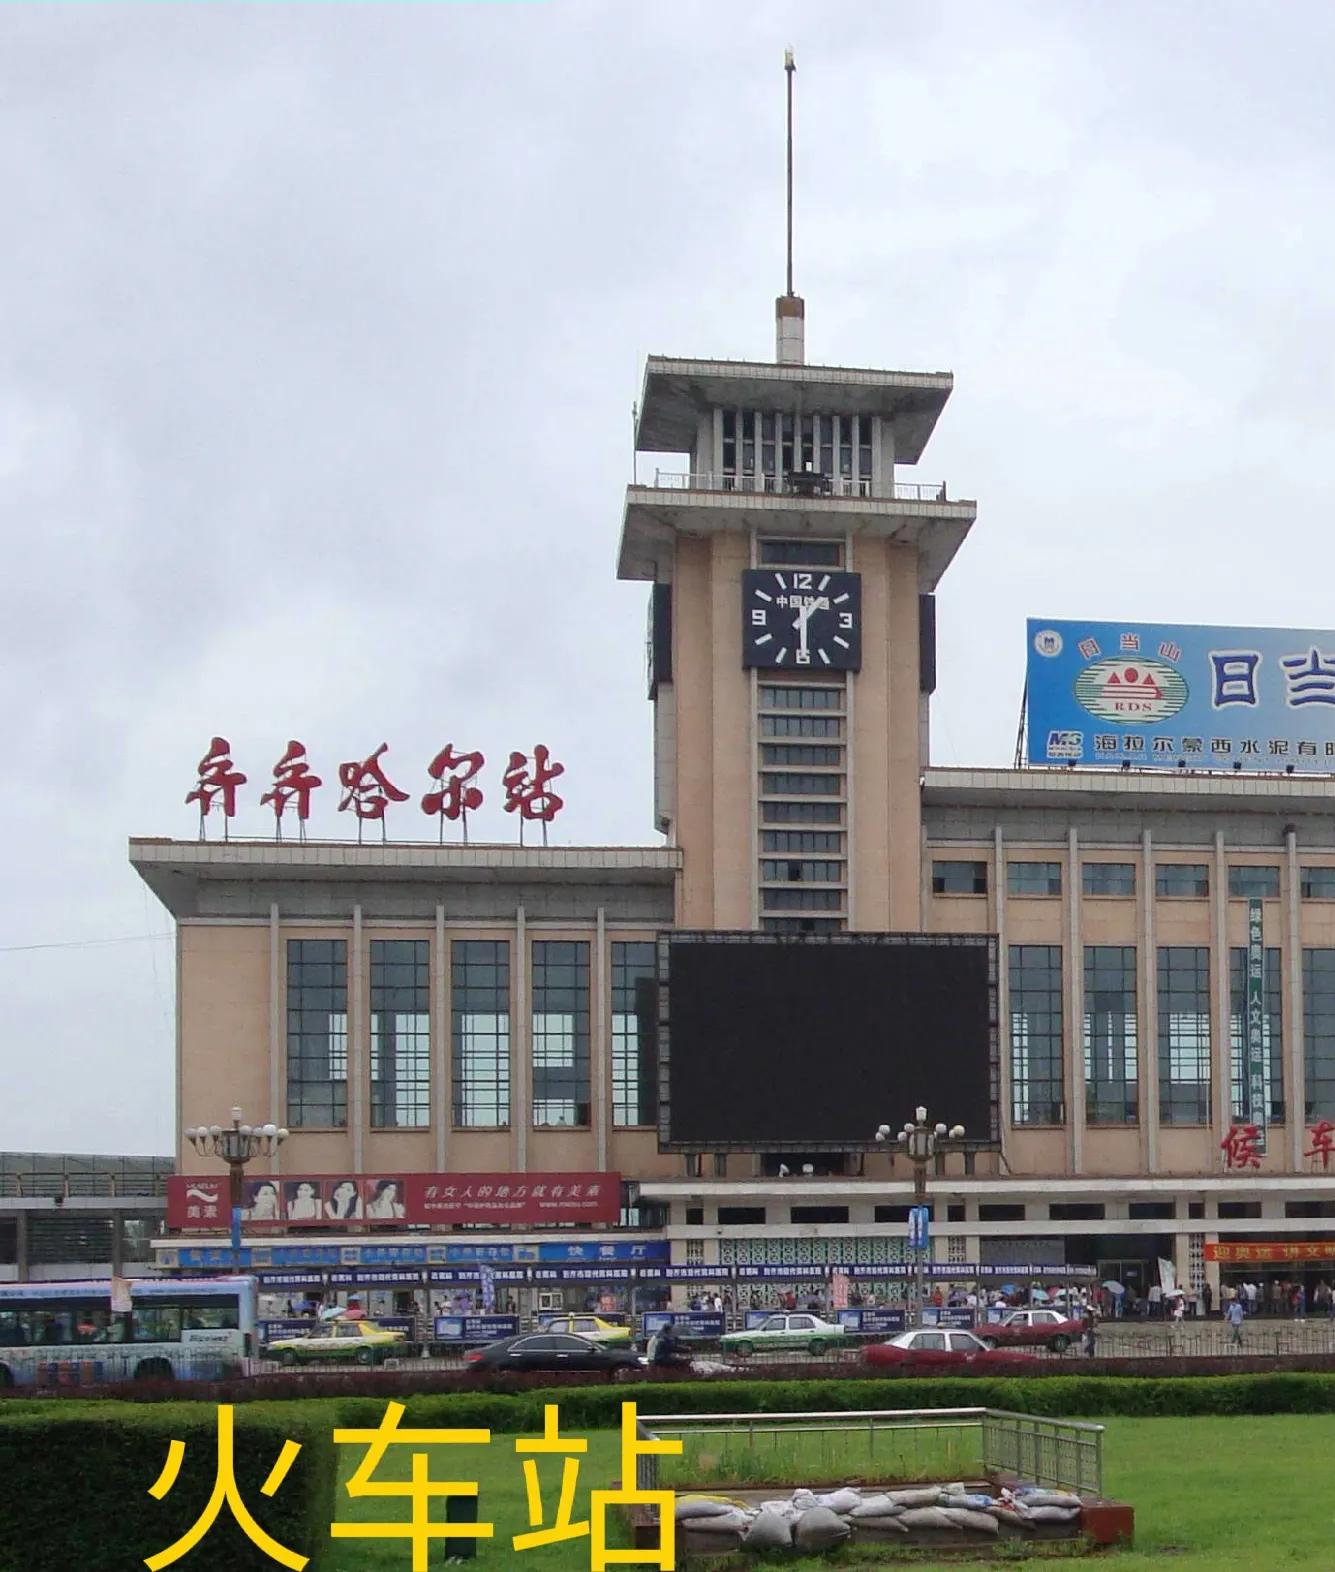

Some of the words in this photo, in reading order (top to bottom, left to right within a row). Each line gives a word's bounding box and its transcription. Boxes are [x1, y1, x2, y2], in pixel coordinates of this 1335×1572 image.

[793, 573, 813, 590] 12
[752, 609, 766, 626] 9
[839, 612, 853, 629] 3
[1078, 631, 1182, 663] 日当山
[1114, 702, 1153, 712] RDS
[185, 736, 565, 822] 齐齐哈尔站
